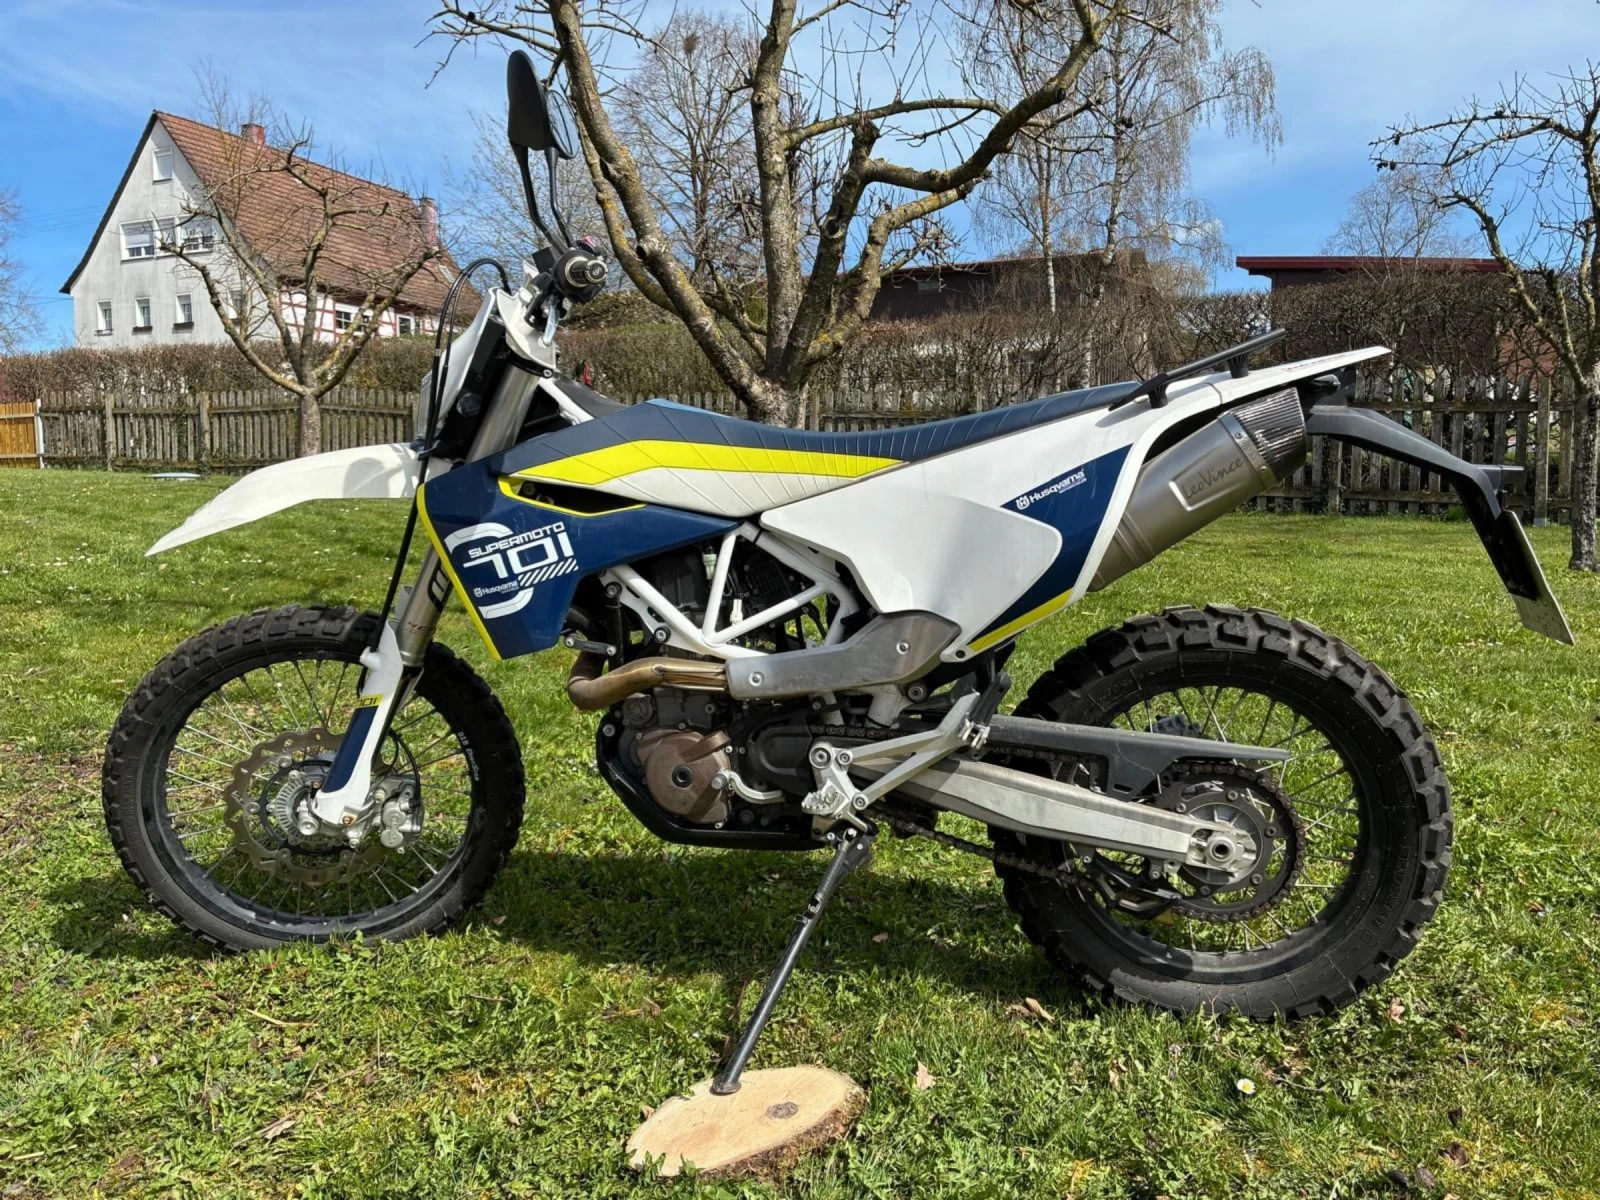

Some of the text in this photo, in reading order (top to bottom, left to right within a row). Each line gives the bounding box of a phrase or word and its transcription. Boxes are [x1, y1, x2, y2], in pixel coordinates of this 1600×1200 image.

[1028, 471, 1086, 503] Husqvarna
[1181, 457, 1243, 499] LeoVince
[463, 532, 574, 578] 701
[468, 521, 565, 558] SUPERMOTO
